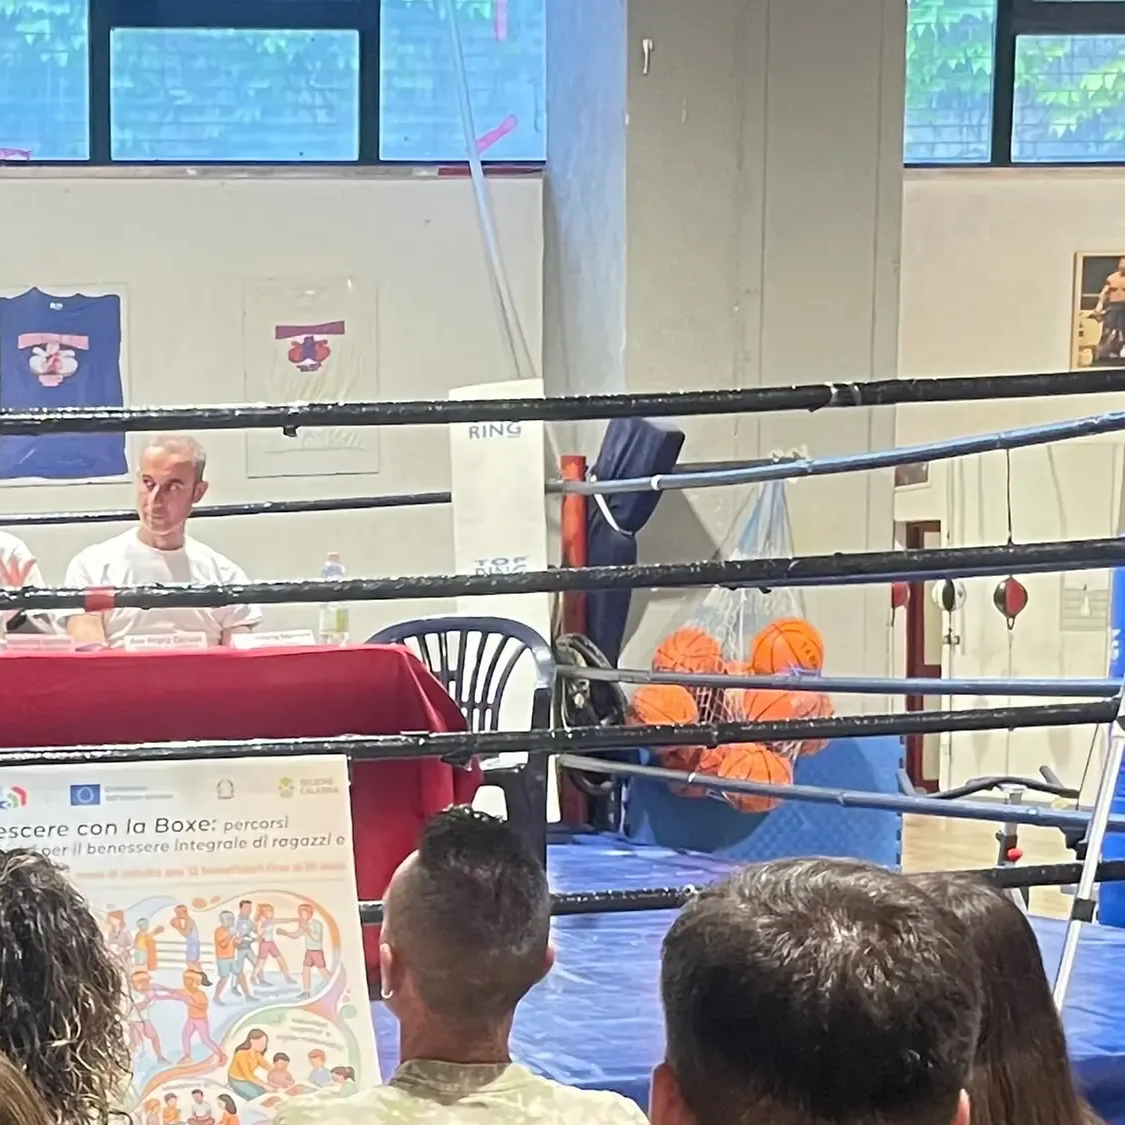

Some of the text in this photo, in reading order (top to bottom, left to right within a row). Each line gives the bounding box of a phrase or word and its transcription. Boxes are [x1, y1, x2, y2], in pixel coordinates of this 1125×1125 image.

[469, 423, 522, 439] RING
[77, 823, 117, 836] con
[127, 818, 146, 834] la
[155, 818, 217, 833] Boxe:
[223, 815, 289, 834] percorsi
[87, 842, 170, 856] benessere
[174, 836, 248, 853] integrale
[253, 834, 268, 849] di
[272, 833, 331, 850] ragazzi
